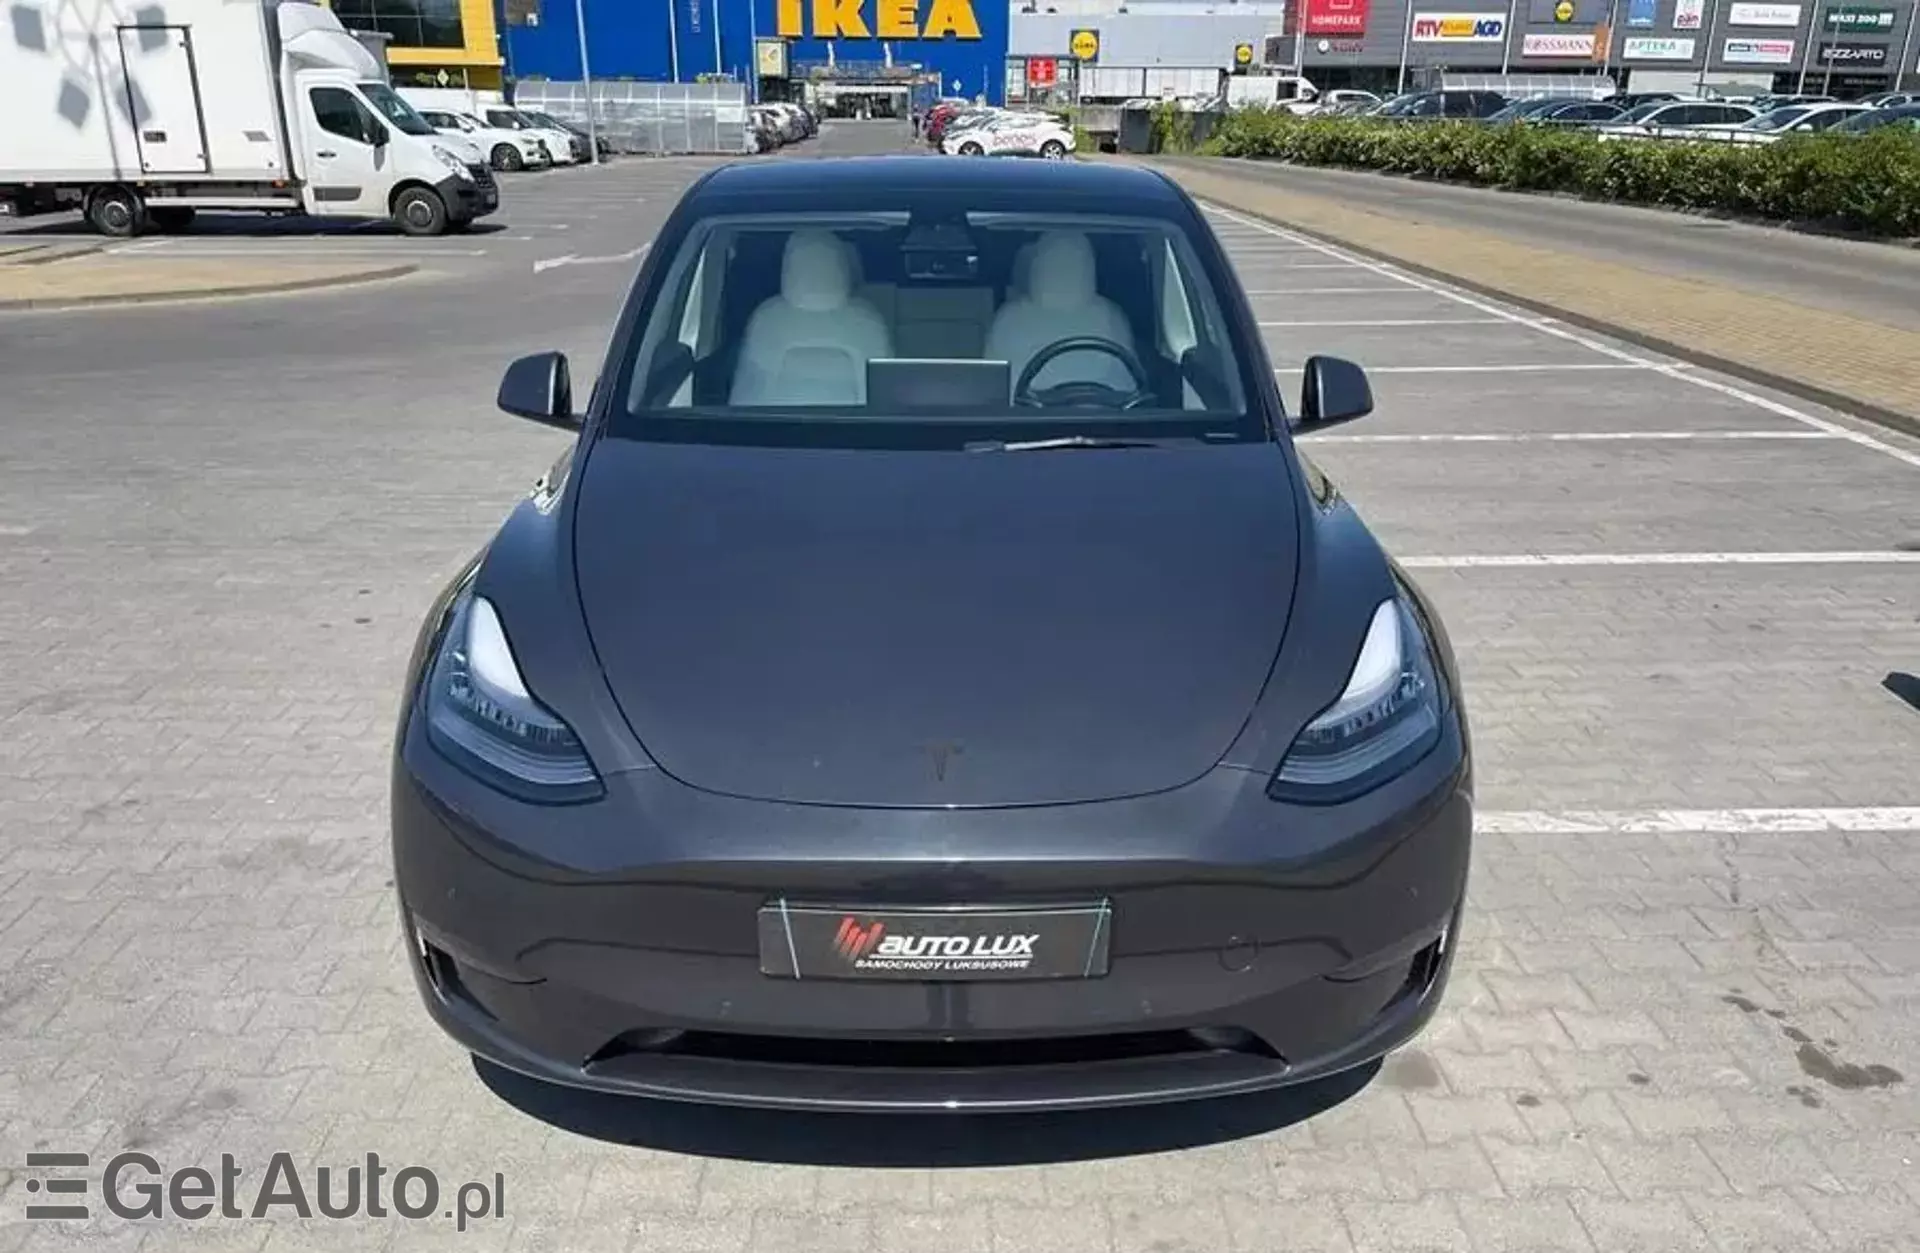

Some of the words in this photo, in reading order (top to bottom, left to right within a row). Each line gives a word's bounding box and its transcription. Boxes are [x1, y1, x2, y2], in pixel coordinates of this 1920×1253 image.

[777, 0, 982, 38] IKEA
[1415, 19, 1443, 36] RTV
[1474, 20, 1502, 37] AGD
[972, 934, 1040, 955] LUX
[854, 959, 943, 970] SAMOCHODY
[945, 959, 1031, 969] LUKSUSOWE
